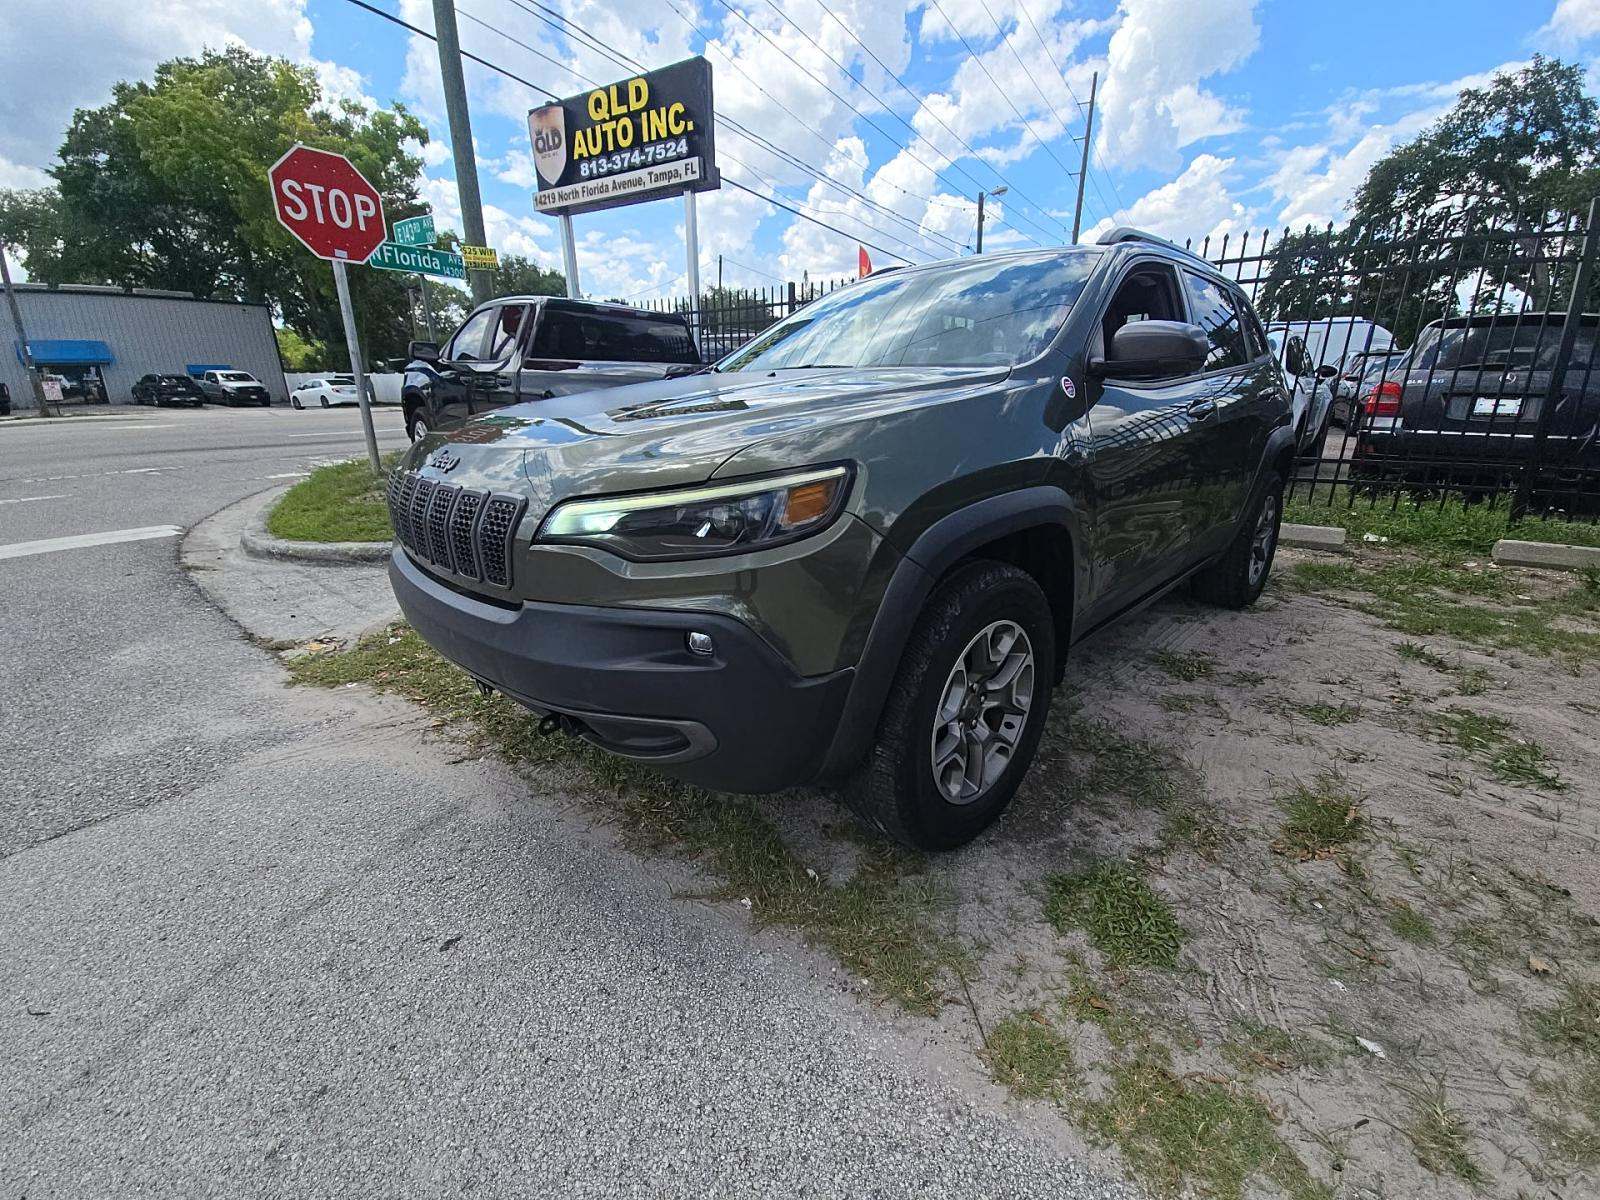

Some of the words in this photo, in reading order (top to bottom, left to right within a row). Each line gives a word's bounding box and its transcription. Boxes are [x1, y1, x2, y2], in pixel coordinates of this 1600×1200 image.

[587, 77, 649, 121] QLD
[534, 127, 562, 154] QLD
[573, 116, 634, 160] AUTO
[641, 102, 694, 143] INC.
[580, 138, 689, 177] 813-374-7524
[535, 189, 557, 208] 14219
[557, 185, 580, 203] North
[581, 181, 610, 199] Florida
[611, 176, 646, 197] Avenue,
[647, 167, 682, 185] Tampa,
[684, 162, 697, 176] FL
[281, 178, 376, 232] STOP
[397, 228, 404, 243] E
[422, 217, 434, 229] AVE
[382, 245, 441, 270] Florida
[448, 254, 463, 267] AVE
[442, 266, 465, 279] 14300
[430, 449, 461, 474] Jeep
